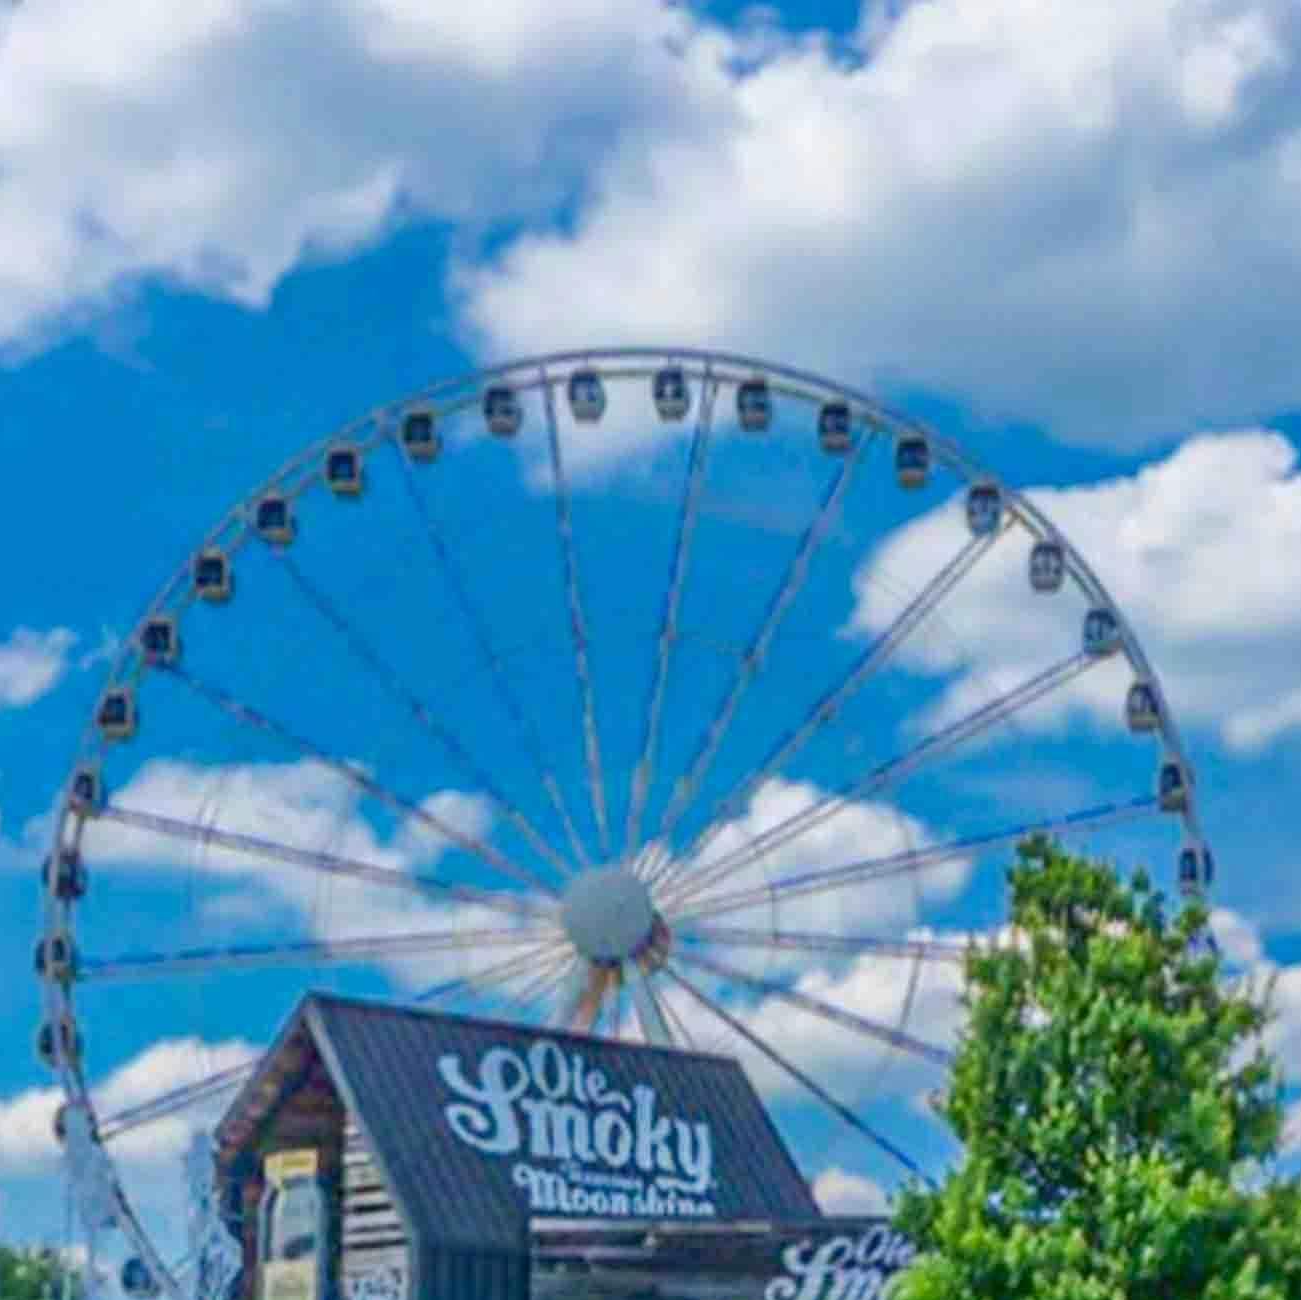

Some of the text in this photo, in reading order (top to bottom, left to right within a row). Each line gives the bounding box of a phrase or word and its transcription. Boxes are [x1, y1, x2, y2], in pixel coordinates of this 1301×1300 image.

[525, 1038, 632, 1112] Ole
[437, 1045, 714, 1193] Smoky
[512, 1161, 716, 1215] Moonshine
